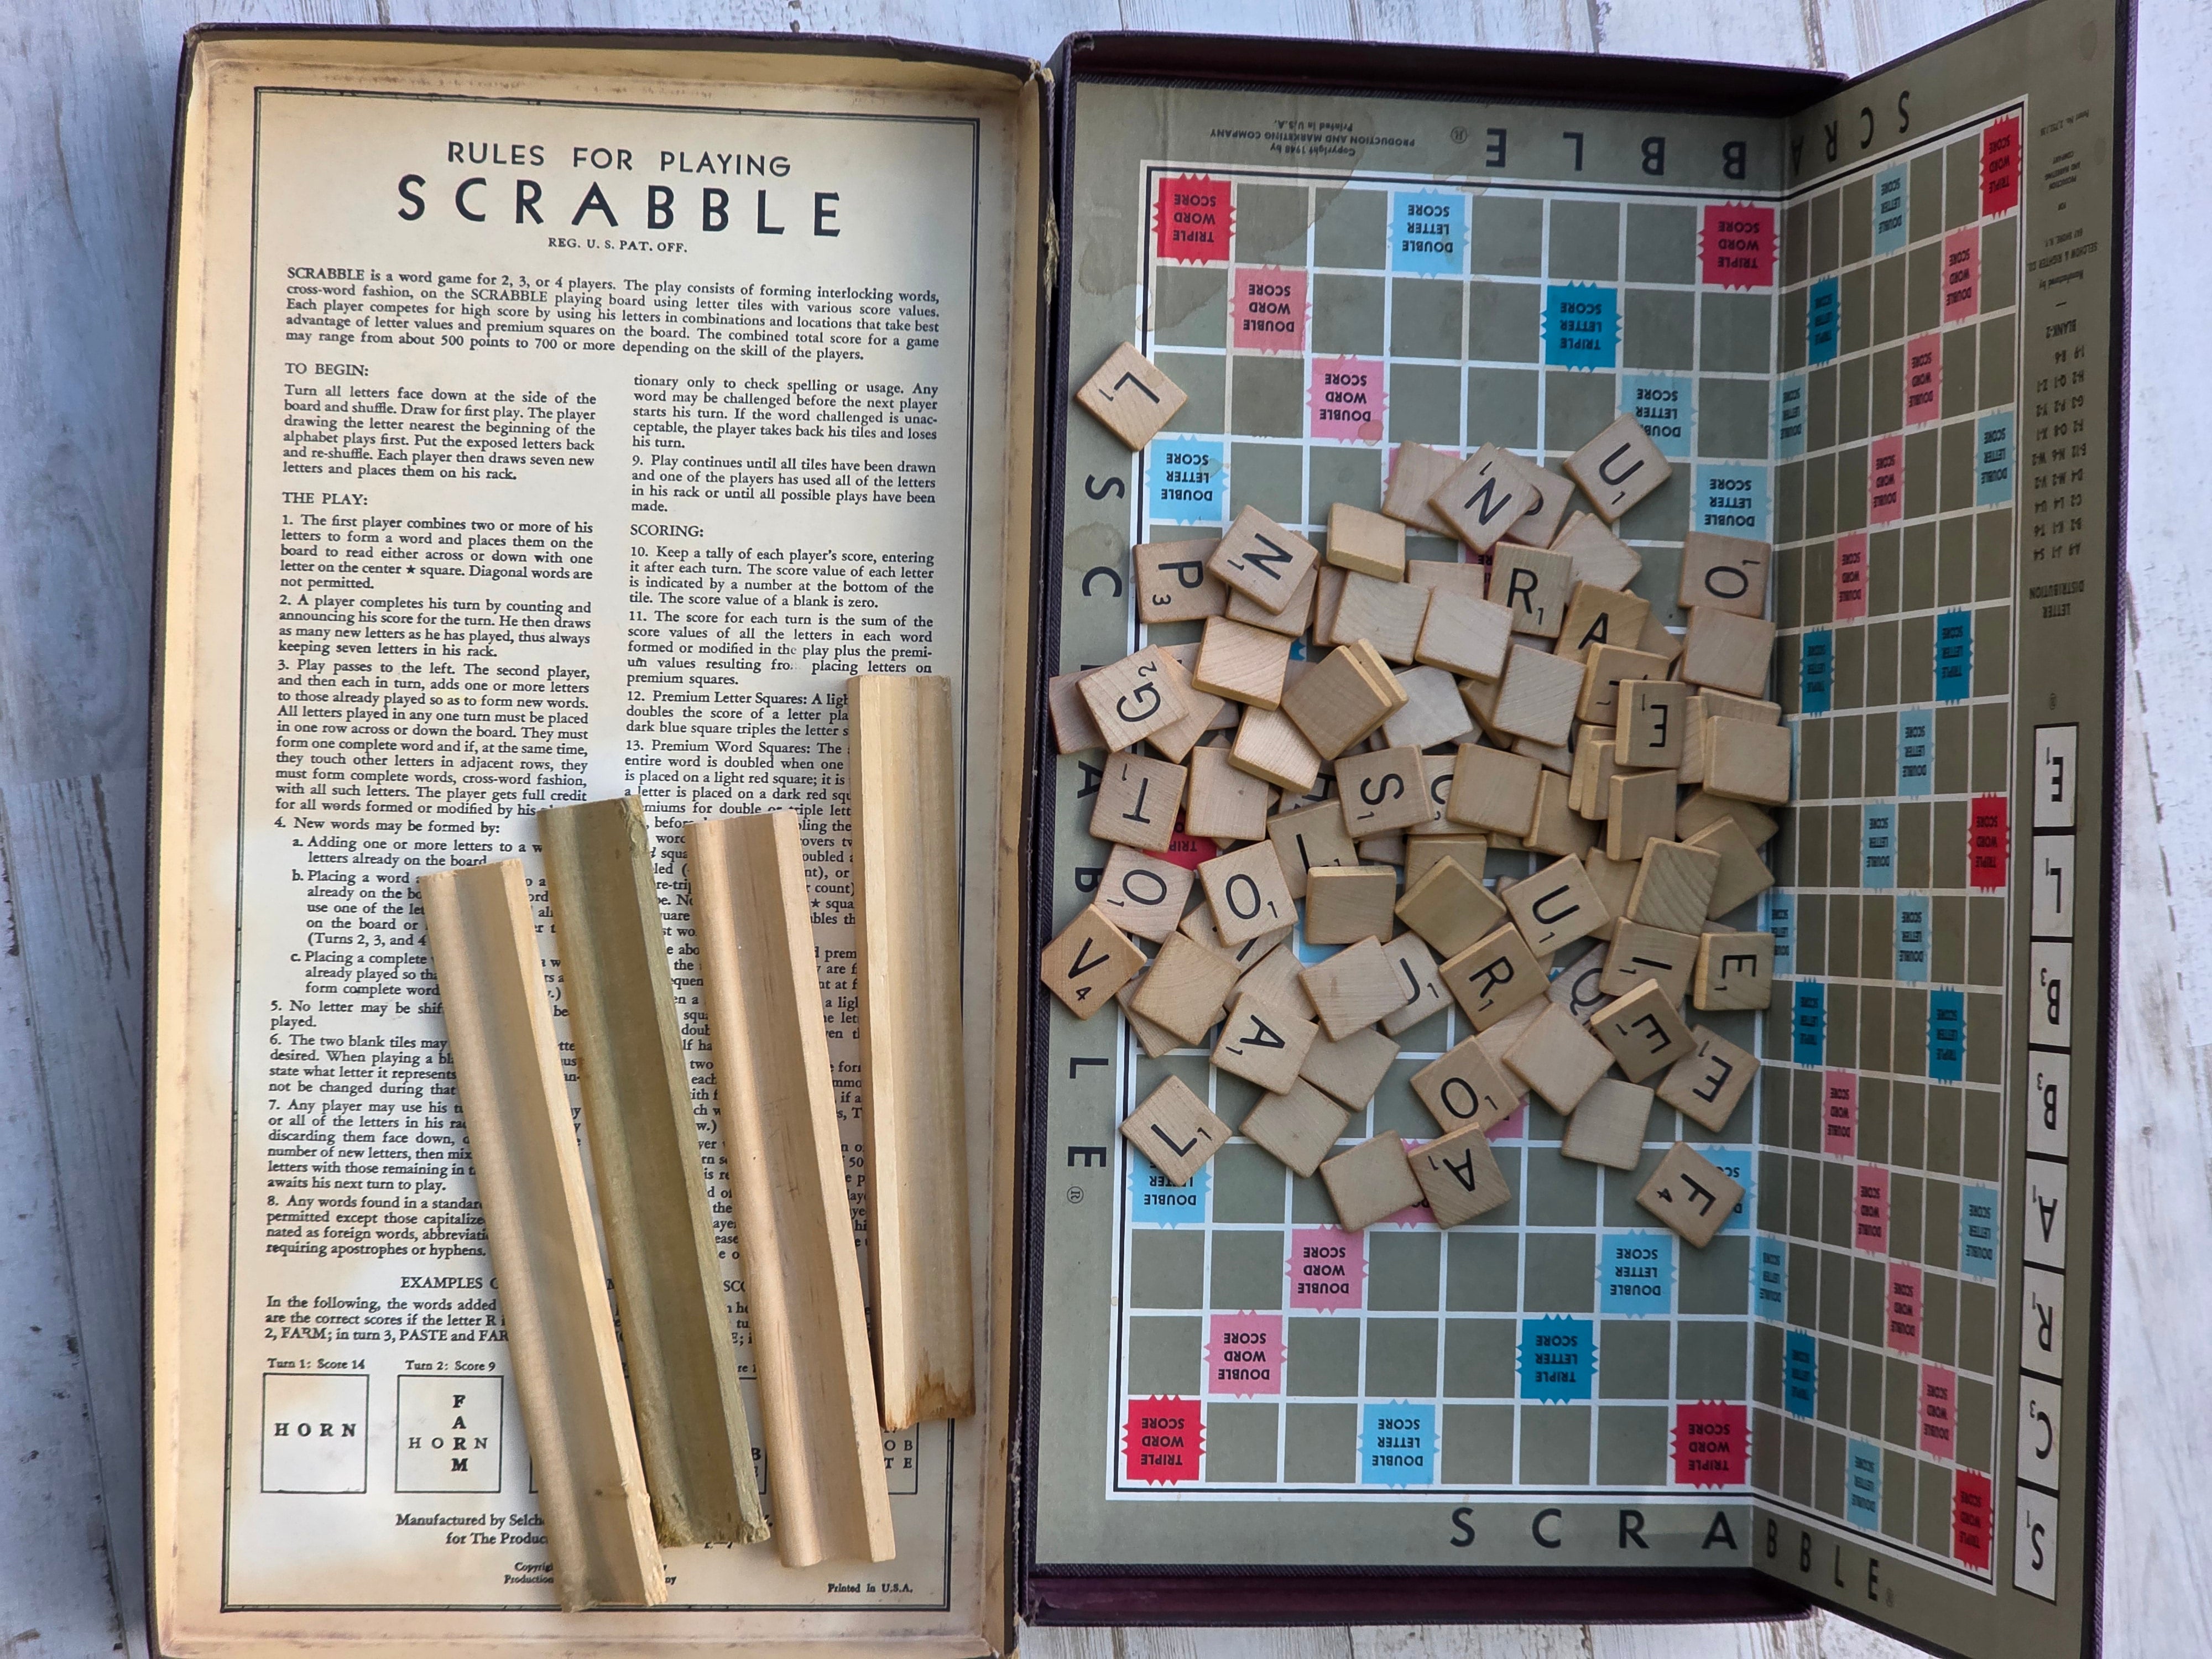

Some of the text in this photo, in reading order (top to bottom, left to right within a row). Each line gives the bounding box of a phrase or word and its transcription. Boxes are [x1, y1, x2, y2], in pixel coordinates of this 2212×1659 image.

[1210, 129, 1415, 147] PRODUCTION AND MARKETING COMPANY
[1989, 134, 2011, 155] SCORE
[1270, 142, 1356, 156] Copyright 1948 by
[448, 141, 791, 177] RULES FOR PLAYING
[1989, 155, 2010, 174] WORD
[1989, 175, 2010, 194] TRIPLE
[397, 173, 841, 238] SCRABBLE
[1174, 194, 1217, 207] SCORE
[1408, 205, 1450, 217] SCORE
[1174, 212, 1215, 225] WORD
[1407, 222, 1449, 236] LETTER
[1718, 221, 1761, 234] SCORE
[1173, 229, 1214, 243] TRIPLE
[548, 237, 687, 253] REG. U. S. PAT. OFF.
[1402, 240, 1453, 253] DOUBLE
[1718, 238, 1759, 252] WORD
[1717, 257, 1759, 269] TRIPLE
[1949, 248, 1970, 267] SCORE
[1949, 268, 1970, 285] WORD
[288, 267, 364, 280] SCRABBLE
[371, 269, 380, 281] is
[399, 271, 432, 283] word
[437, 275, 472, 287] game
[477, 273, 497, 285] for
[502, 275, 513, 288] 2,
[519, 275, 530, 289] 3,
[536, 279, 550, 287] or
[555, 276, 562, 288] 4
[568, 277, 615, 295] players.
[623, 279, 649, 291] The
[655, 280, 681, 299] play
[687, 282, 734, 294] consists
[740, 284, 754, 295] of
[760, 284, 811, 302] forming
[817, 286, 893, 304] interlocking
[899, 290, 939, 305] words,
[1249, 284, 1291, 297] SCORE
[1946, 286, 1972, 306] DOUBLE
[1249, 302, 1291, 315] WORD
[1561, 302, 1602, 315] SCORE
[1243, 319, 1295, 332] DOUBLE
[1559, 320, 1602, 332] LETTER
[1559, 337, 1601, 351] TRIPLE
[285, 363, 368, 376] TO BEGIN:
[1166, 453, 1209, 466] SCORE
[1166, 471, 1209, 483] LETTER
[282, 492, 367, 505] THE PLAY:
[1161, 489, 1213, 501] DOUBLE
[632, 500, 667, 512] made.
[630, 524, 703, 537] SCORING:
[632, 546, 648, 557] 10.
[656, 546, 688, 562] Keep
[706, 547, 734, 562] tally
[738, 547, 753, 559] of
[757, 548, 784, 560] each
[789, 549, 837, 564] player's
[842, 553, 877, 565] score,
[882, 551, 935, 567] entering
[280, 576, 374, 591] not permitted.
[2030, 580, 2085, 599] DISTRIBUTION
[279, 594, 591, 615] 2. A player completes his turn by counting and
[2043, 602, 2071, 618] LETTER
[1905, 726, 1926, 739] SCORE
[1904, 745, 1924, 758] LETTER
[1902, 764, 1927, 778] DOUBLE
[270, 1015, 316, 1030] played.
[265, 1241, 327, 1258] requiring
[331, 1243, 408, 1259] apostrophes
[429, 1244, 486, 1260] hyphens.
[1303, 1247, 1346, 1258] SCORE
[1303, 1265, 1345, 1276] WORD
[400, 1276, 483, 1289] EXAMPLES
[1298, 1283, 1349, 1294] DOUBLE
[267, 1358, 365, 1369] Turn 1: Score 14
[405, 1360, 495, 1371] Turn 2: Score 9
[274, 1423, 356, 1437] HORN
[1142, 1418, 1185, 1430] SCORE
[1378, 1418, 1420, 1430] SCORE
[451, 1395, 468, 1472] FARM
[408, 1437, 488, 1451] HORN
[1142, 1436, 1184, 1447] WORD
[1378, 1437, 1420, 1448] LETTER
[1141, 1454, 1183, 1466] TRIPLE
[1372, 1455, 1423, 1467] DOUBLE
[395, 1514, 506, 1530] Manufactured by
